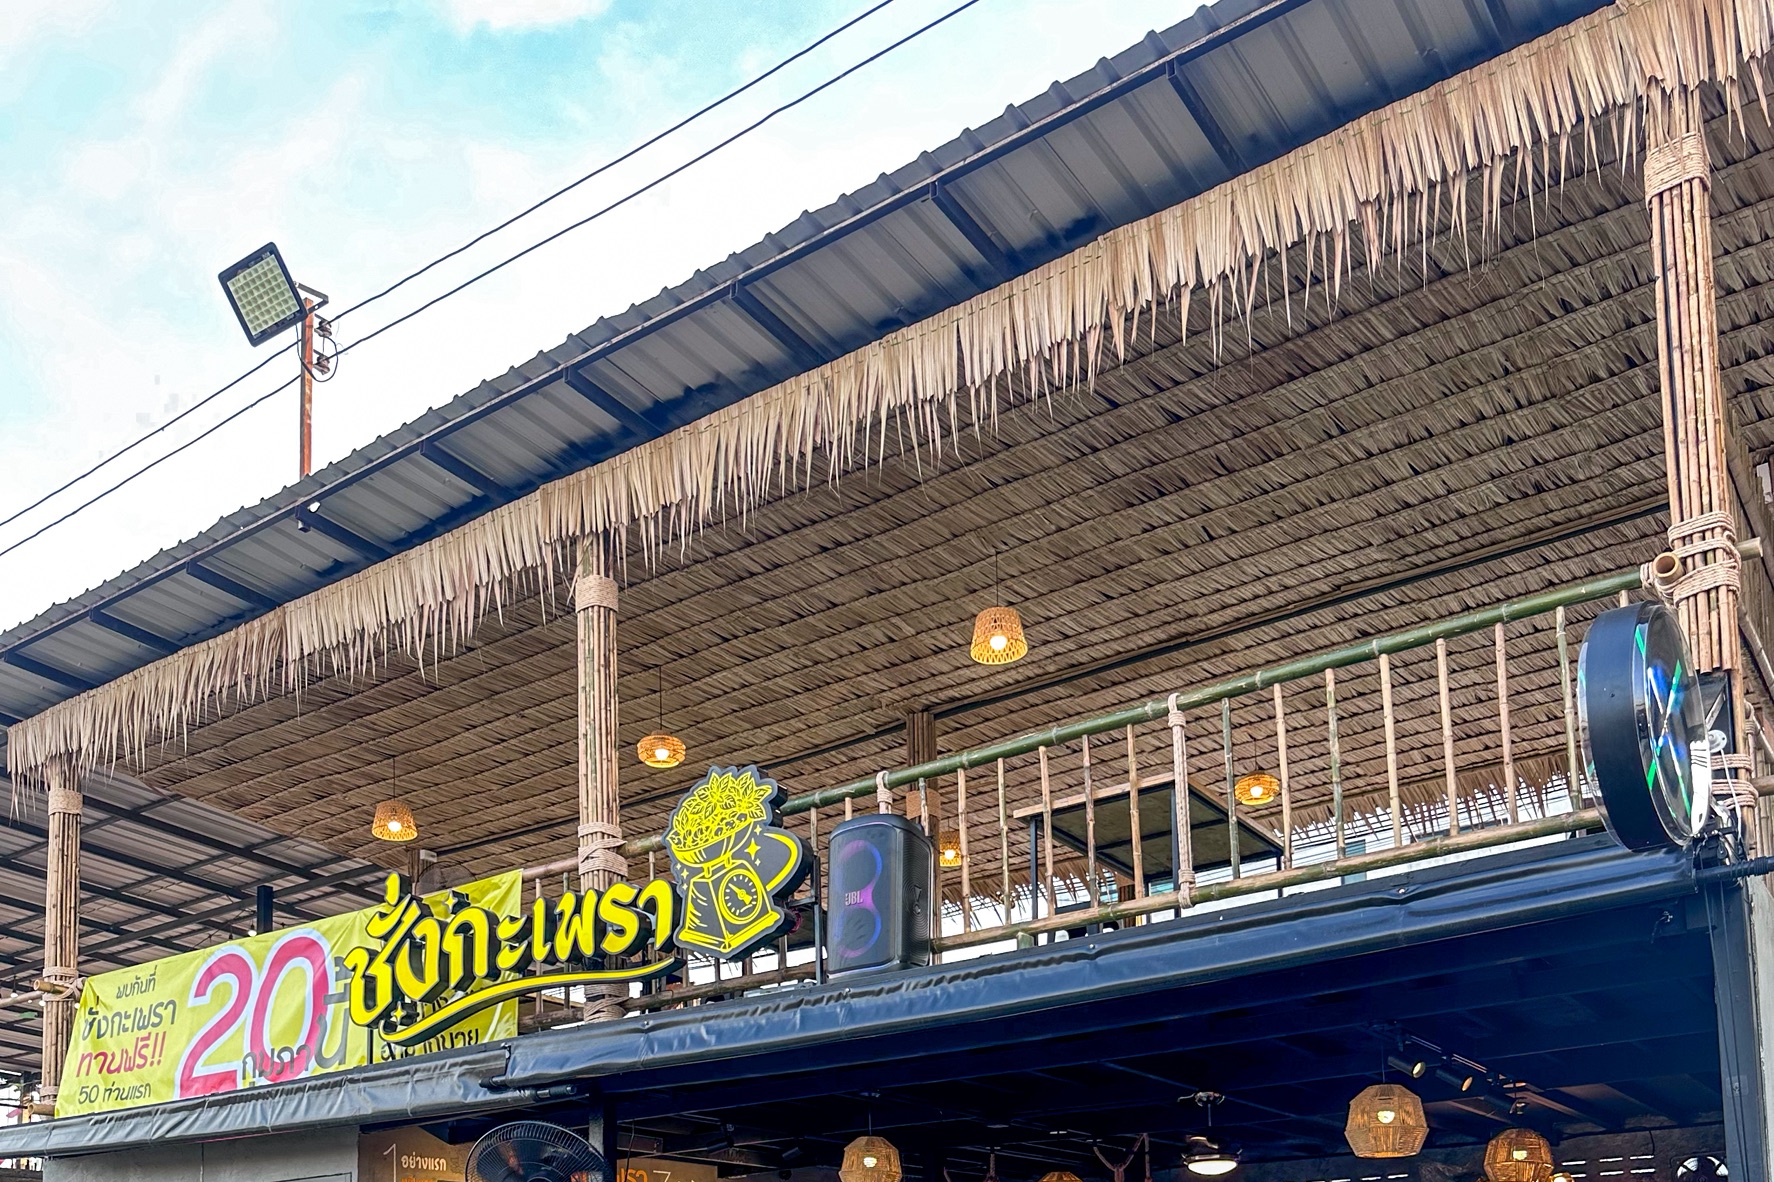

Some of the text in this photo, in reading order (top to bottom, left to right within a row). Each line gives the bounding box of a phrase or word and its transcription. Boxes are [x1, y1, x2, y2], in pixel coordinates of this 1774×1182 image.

[844, 891, 864, 905] JBL
[343, 871, 675, 1027] ชั่งกะเพรา
[115, 965, 157, 999] พบกันที่
[81, 997, 177, 1042] ชั่งกะเพรา
[176, 930, 335, 1099] 20
[76, 1031, 167, 1078] ทานฟรี!!
[78, 1081, 151, 1105] 50 ท่านแรก
[401, 1151, 447, 1171] อย่างแรก
